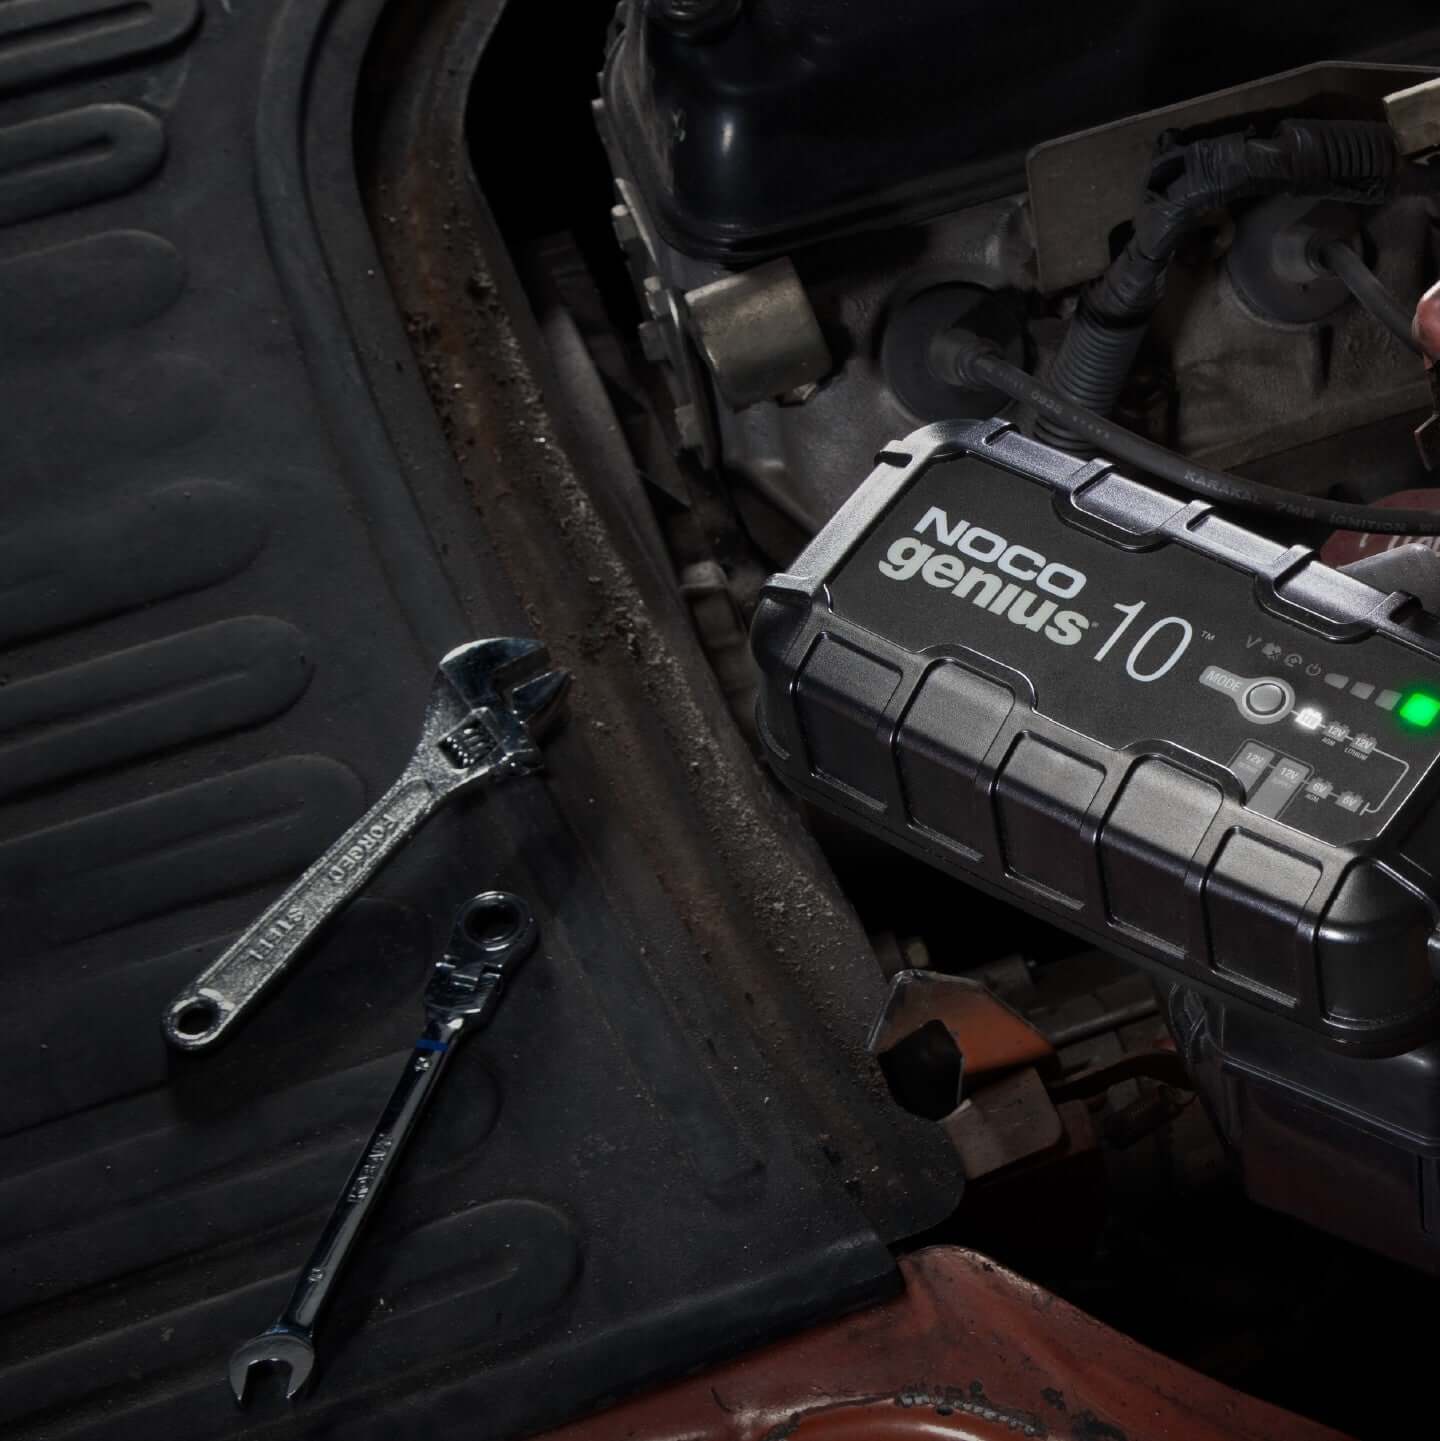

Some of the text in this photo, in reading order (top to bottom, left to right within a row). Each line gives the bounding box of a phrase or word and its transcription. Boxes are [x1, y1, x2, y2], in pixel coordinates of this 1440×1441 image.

[1329, 513, 1408, 533] IGNITION
[913, 506, 1087, 600] NOCO
[878, 536, 1090, 646] genius
[1094, 600, 1193, 682] 10
[1206, 670, 1242, 693] MODE
[1355, 737, 1374, 750] 12V
[1246, 752, 1265, 765] 12V
[1280, 767, 1299, 780] 12V
[328, 813, 399, 885] FORGED
